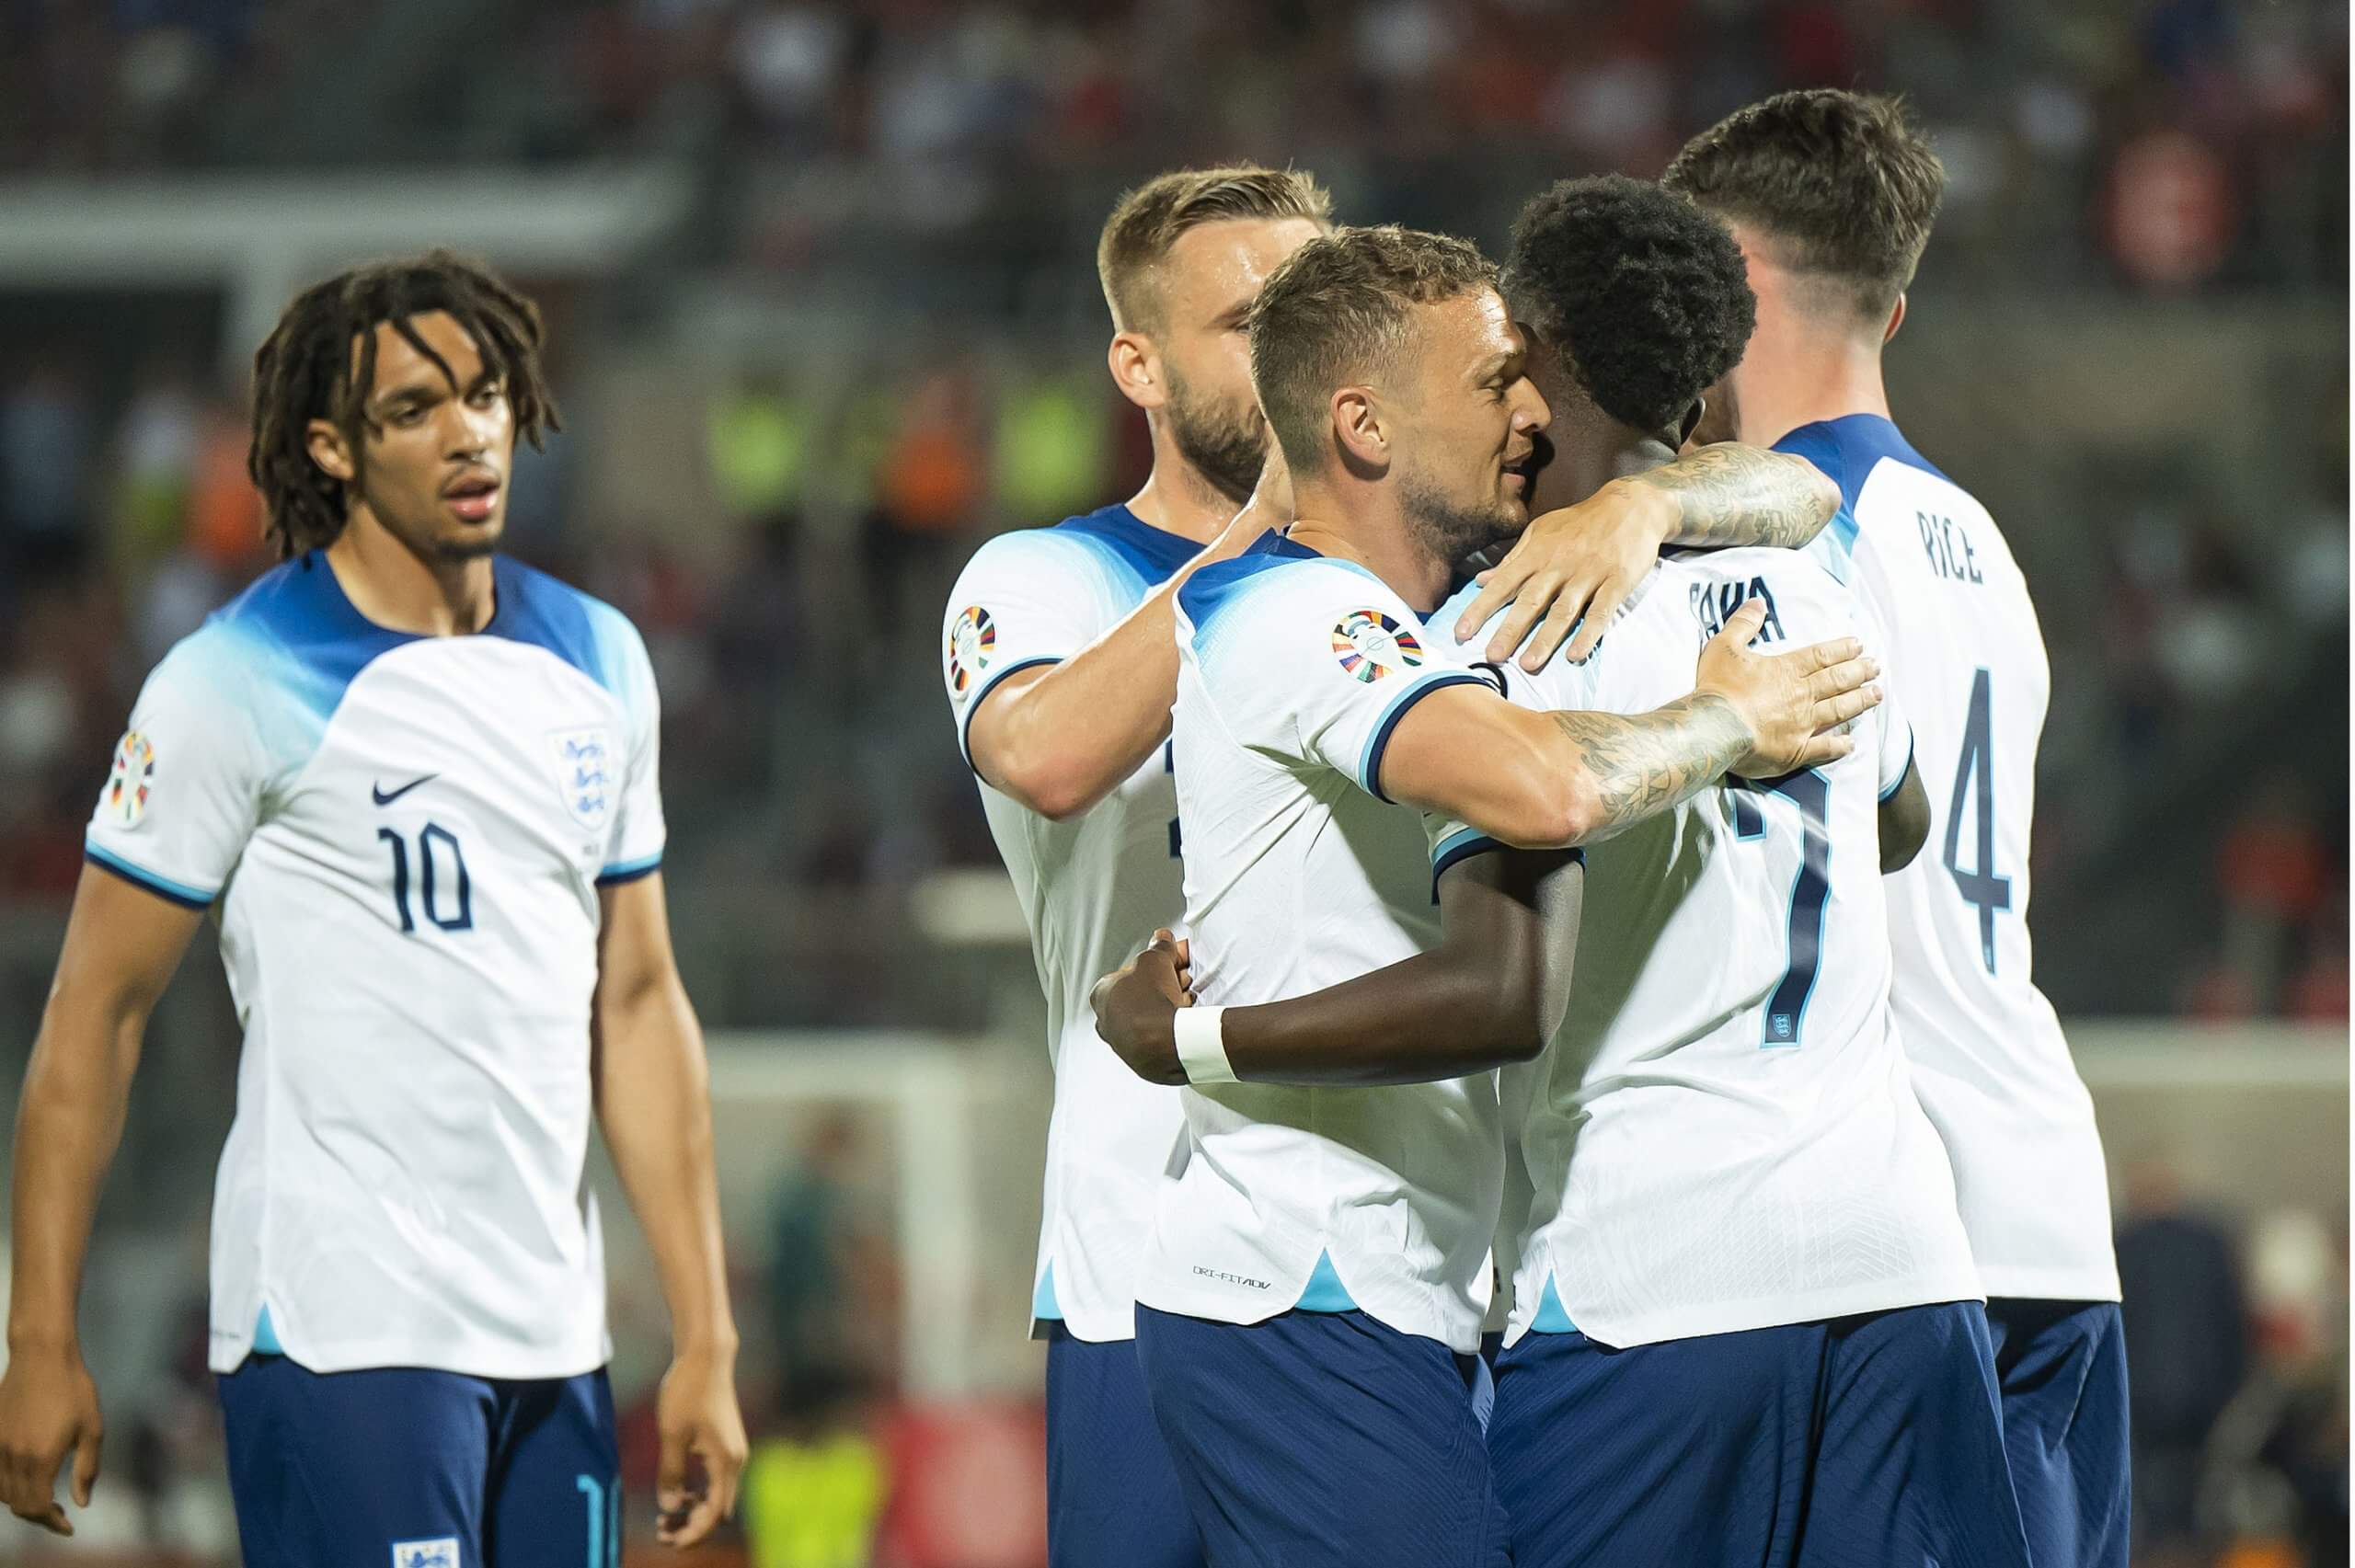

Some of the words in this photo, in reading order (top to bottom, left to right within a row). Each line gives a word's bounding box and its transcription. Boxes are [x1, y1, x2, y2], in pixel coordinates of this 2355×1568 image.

[1916, 511, 1983, 585] RICE
[376, 822, 473, 933] 10
[1733, 767, 1832, 1048] 7
[1942, 669, 2012, 977] 4
